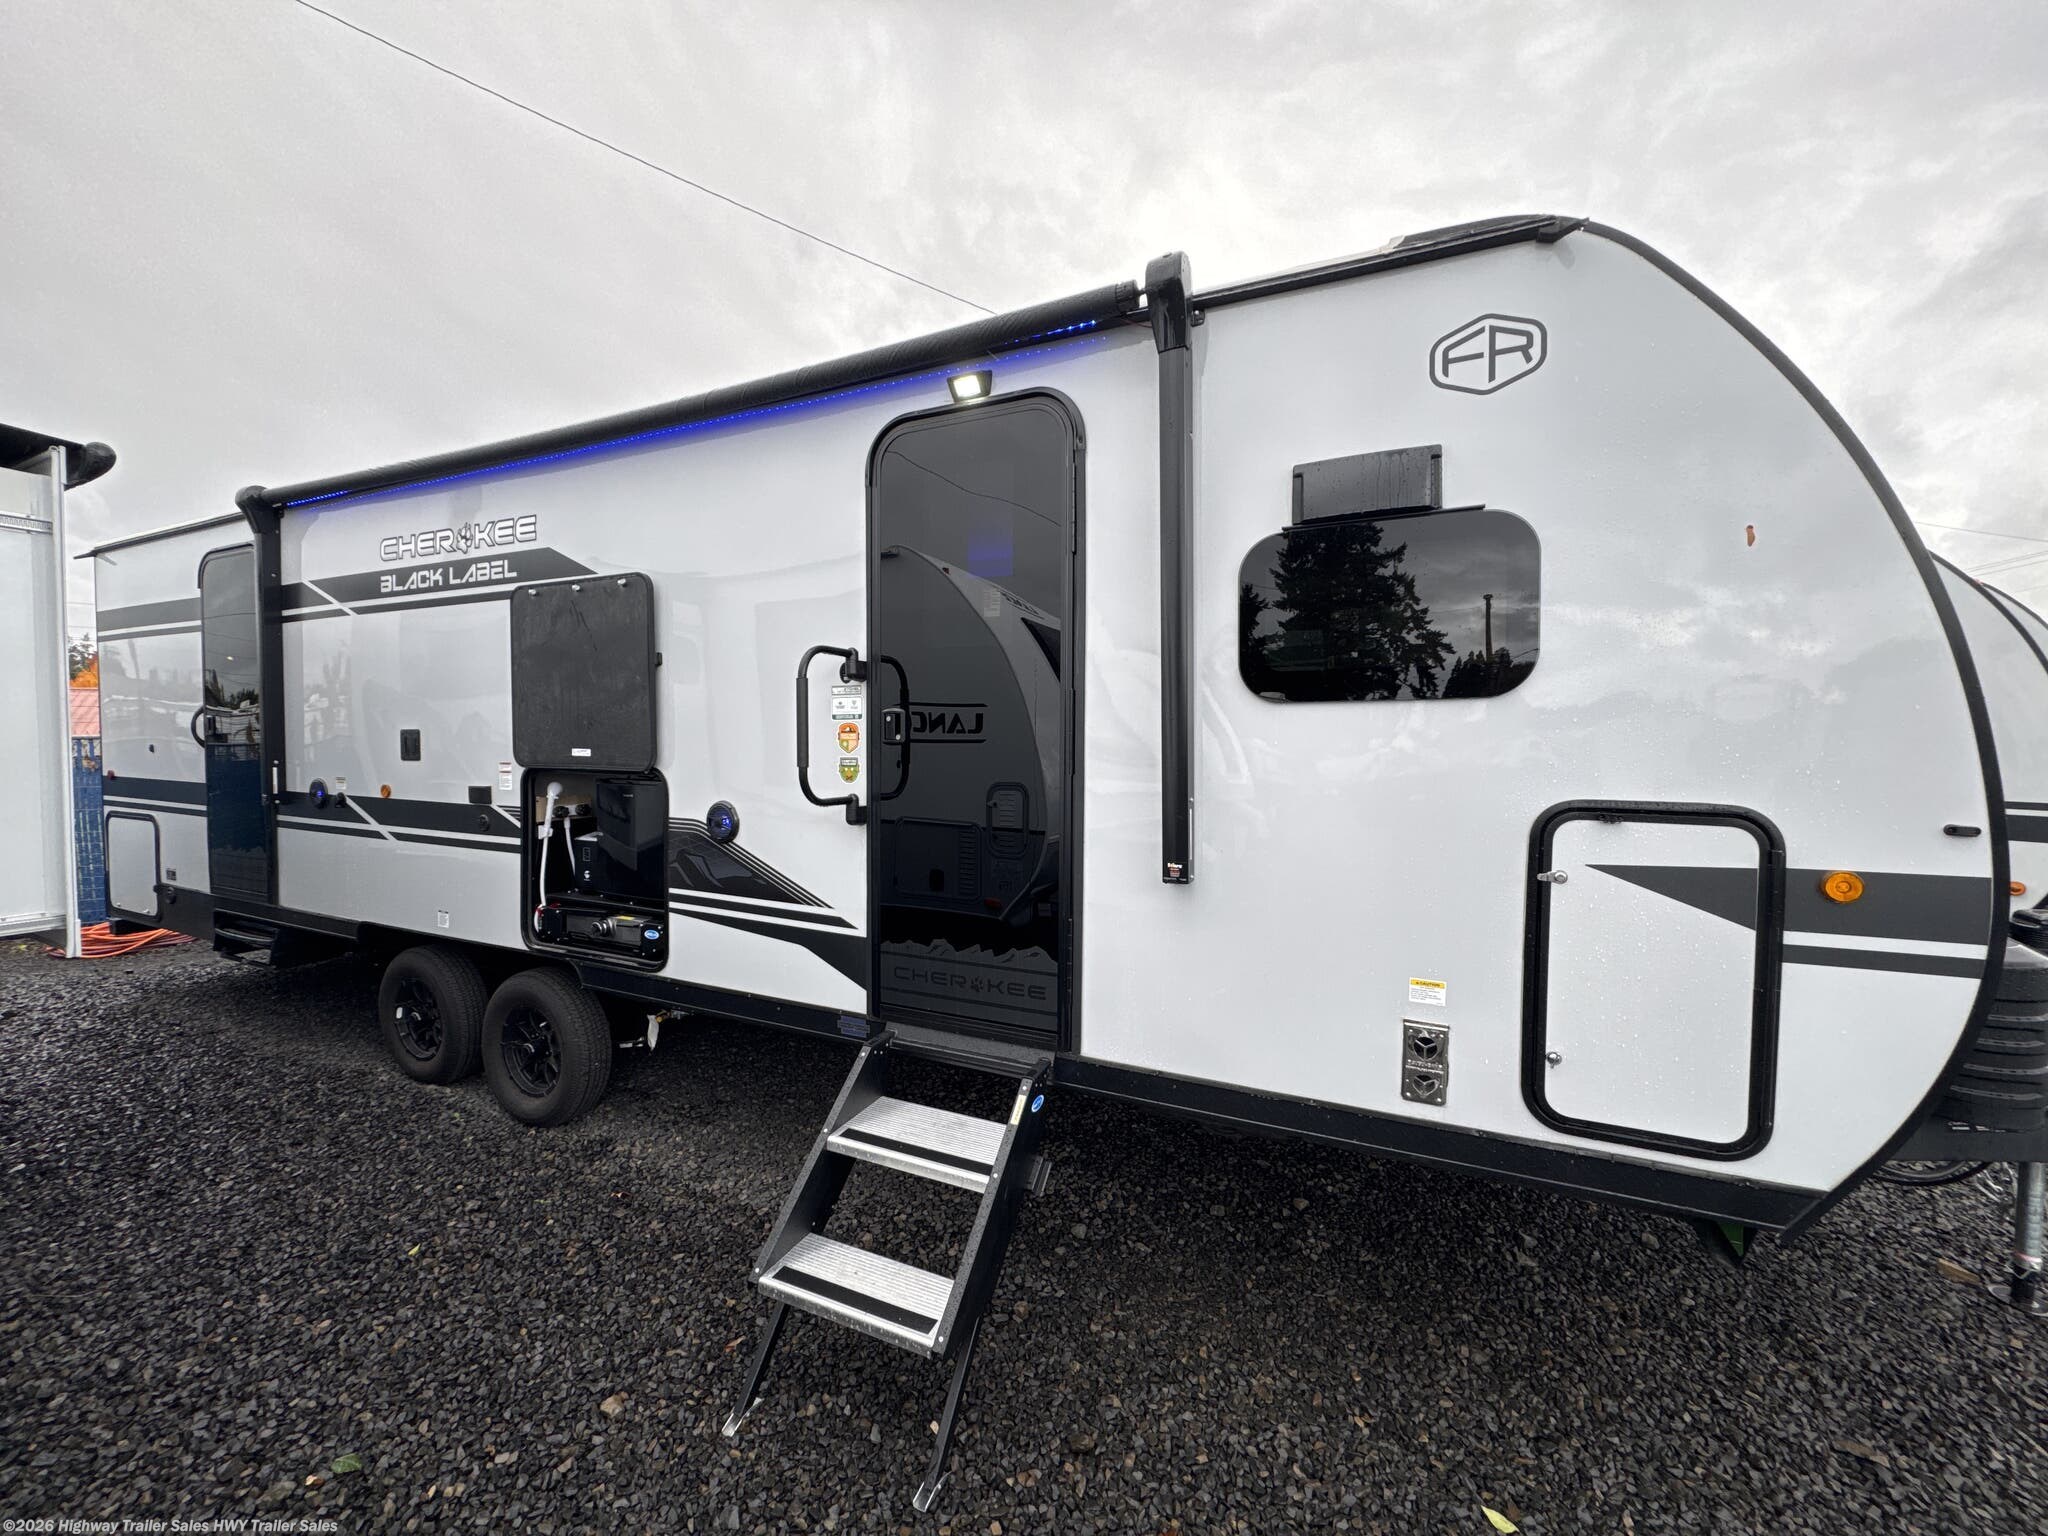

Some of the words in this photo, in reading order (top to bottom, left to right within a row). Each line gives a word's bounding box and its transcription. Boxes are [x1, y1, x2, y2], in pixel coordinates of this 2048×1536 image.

[1441, 324, 1534, 383] FR
[380, 568, 444, 594] BLACK
[449, 559, 518, 585] LABEL
